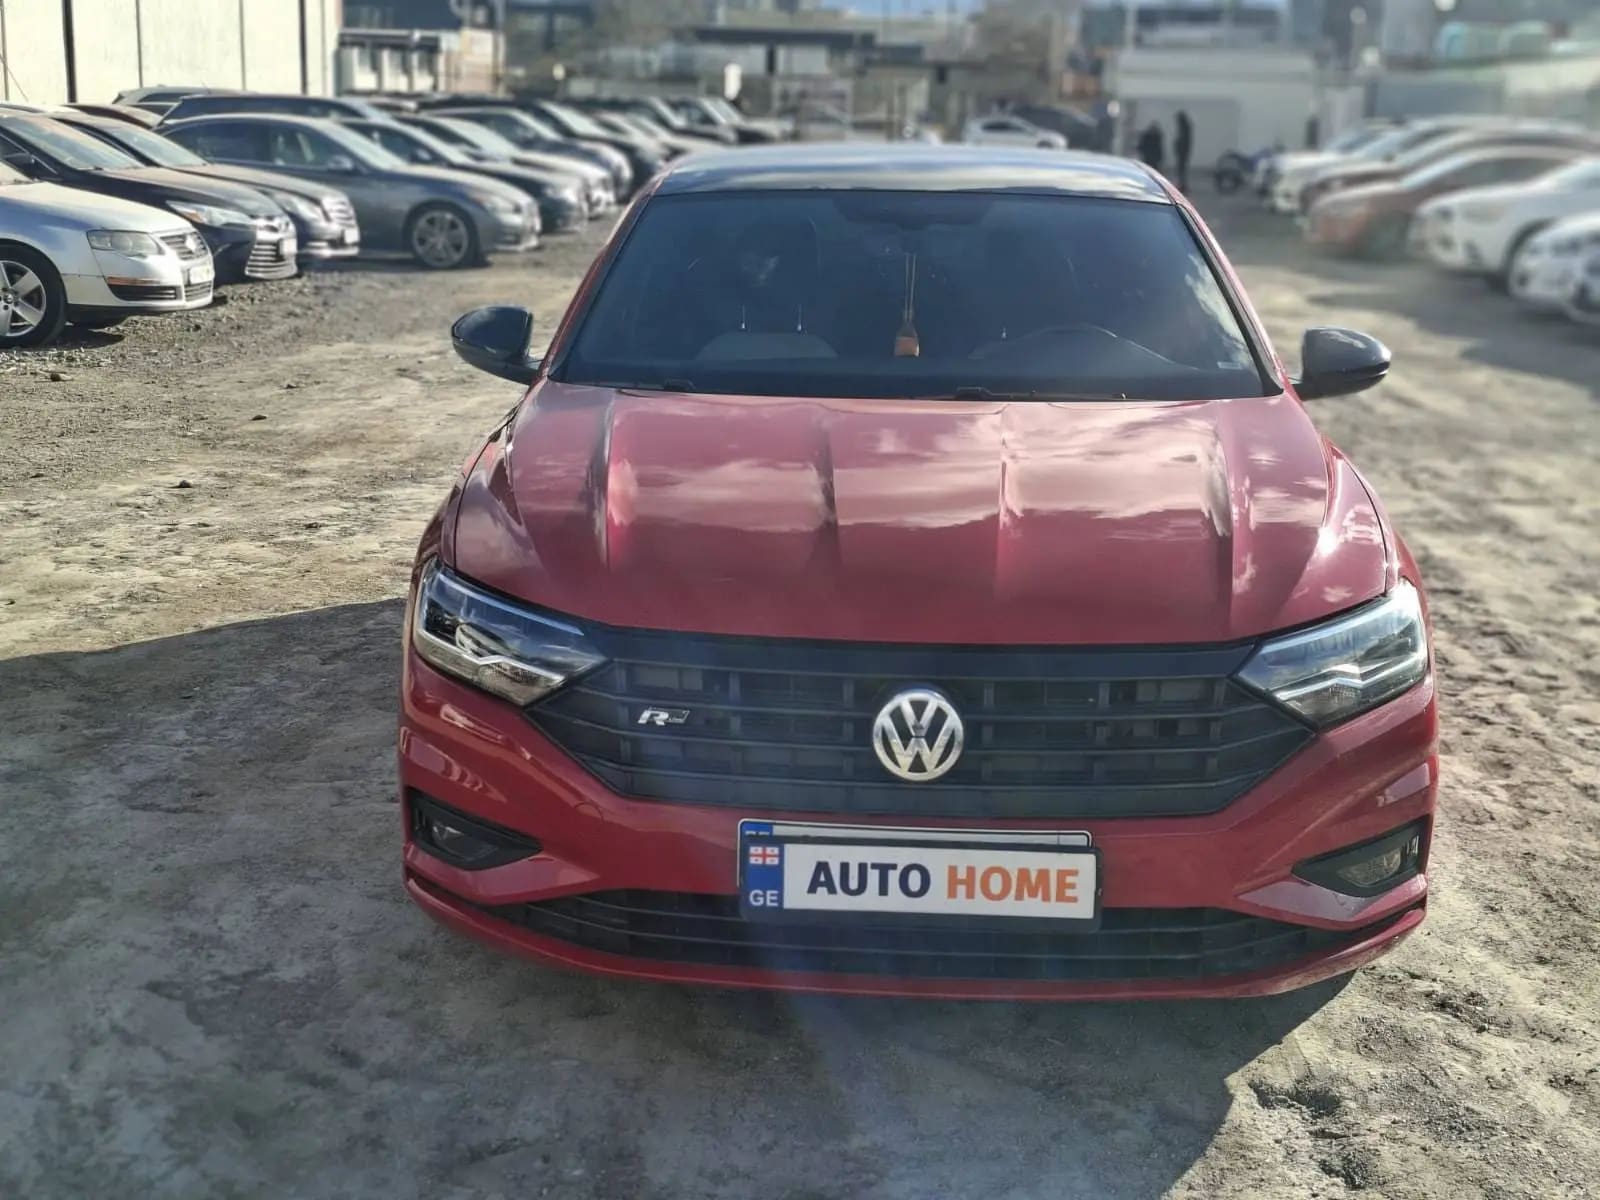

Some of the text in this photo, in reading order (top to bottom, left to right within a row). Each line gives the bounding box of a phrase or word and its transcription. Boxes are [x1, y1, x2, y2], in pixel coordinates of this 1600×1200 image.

[749, 888, 780, 907] GE
[806, 860, 1080, 904] AUTO HOME
